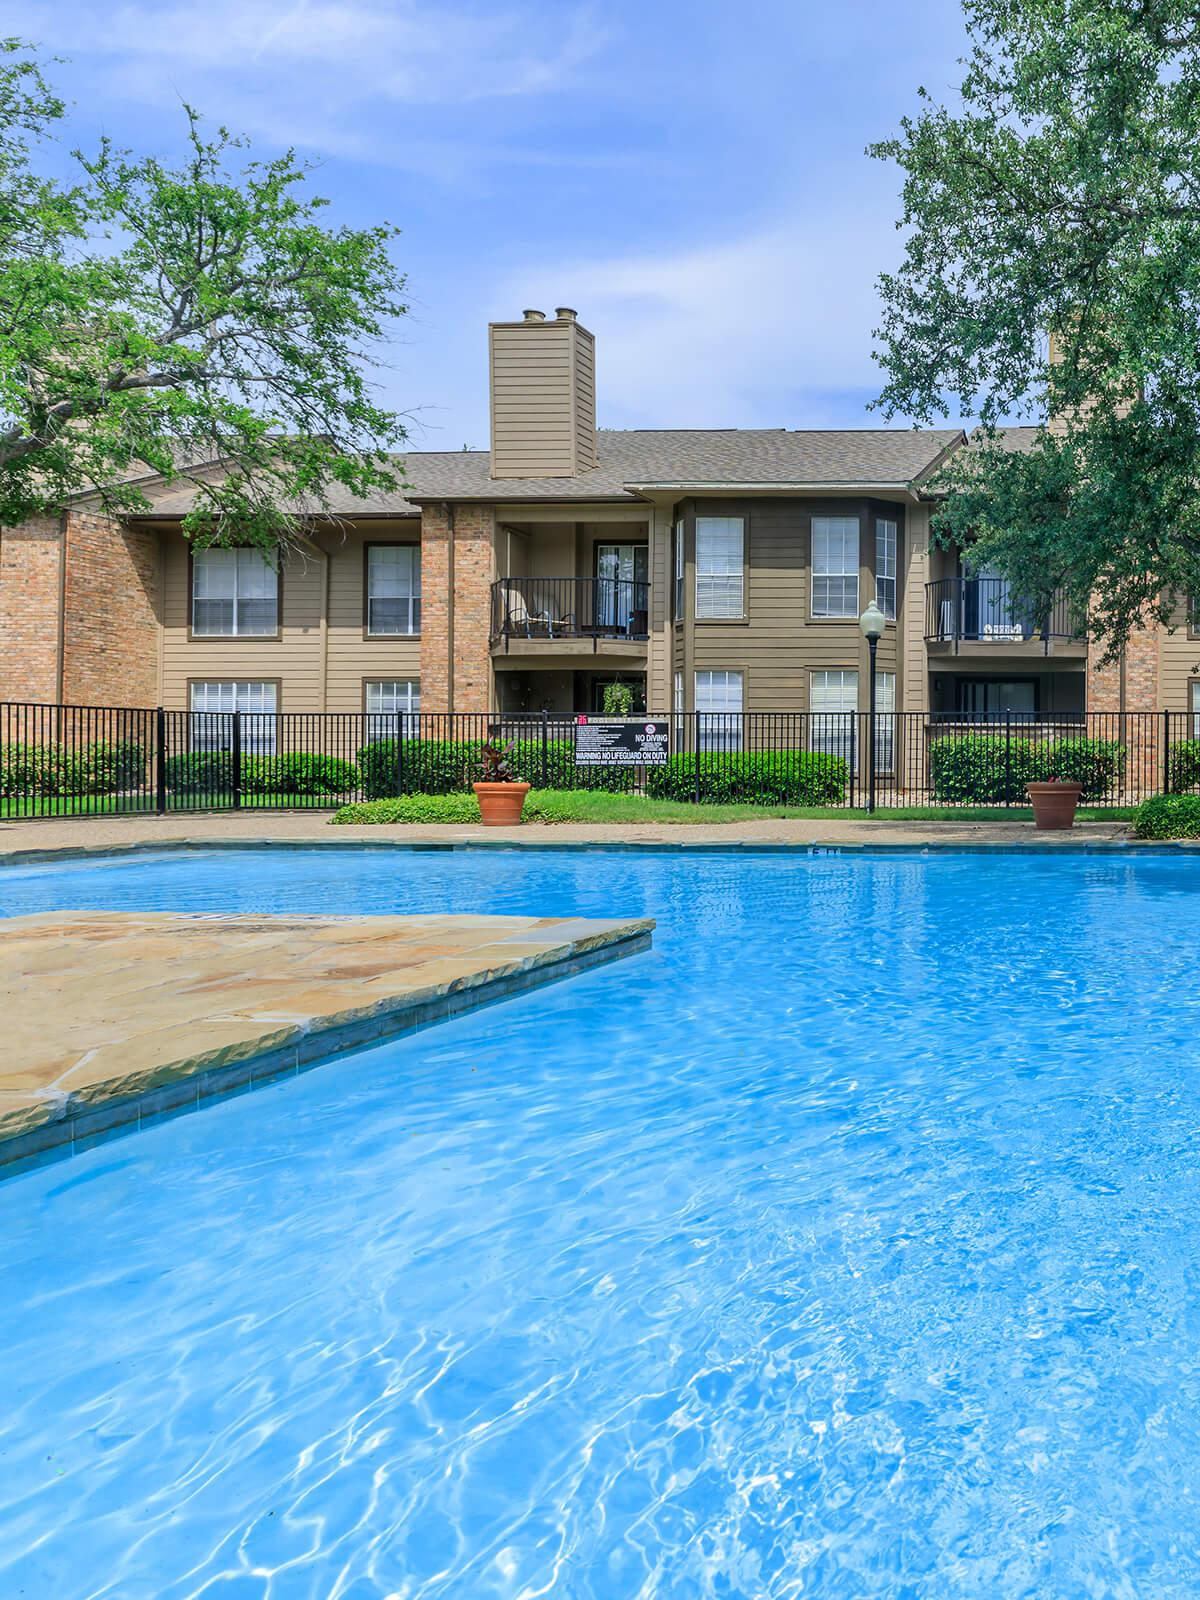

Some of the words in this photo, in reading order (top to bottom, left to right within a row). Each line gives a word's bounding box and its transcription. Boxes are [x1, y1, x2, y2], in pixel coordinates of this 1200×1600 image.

[635, 734, 645, 742] NO
[646, 734, 667, 742] DIVING
[576, 752, 601, 760] WARNING
[602, 752, 610, 760] NO
[611, 752, 641, 760] LIFEGUARD
[642, 752, 651, 760] ON
[652, 752, 667, 760] DUTY
